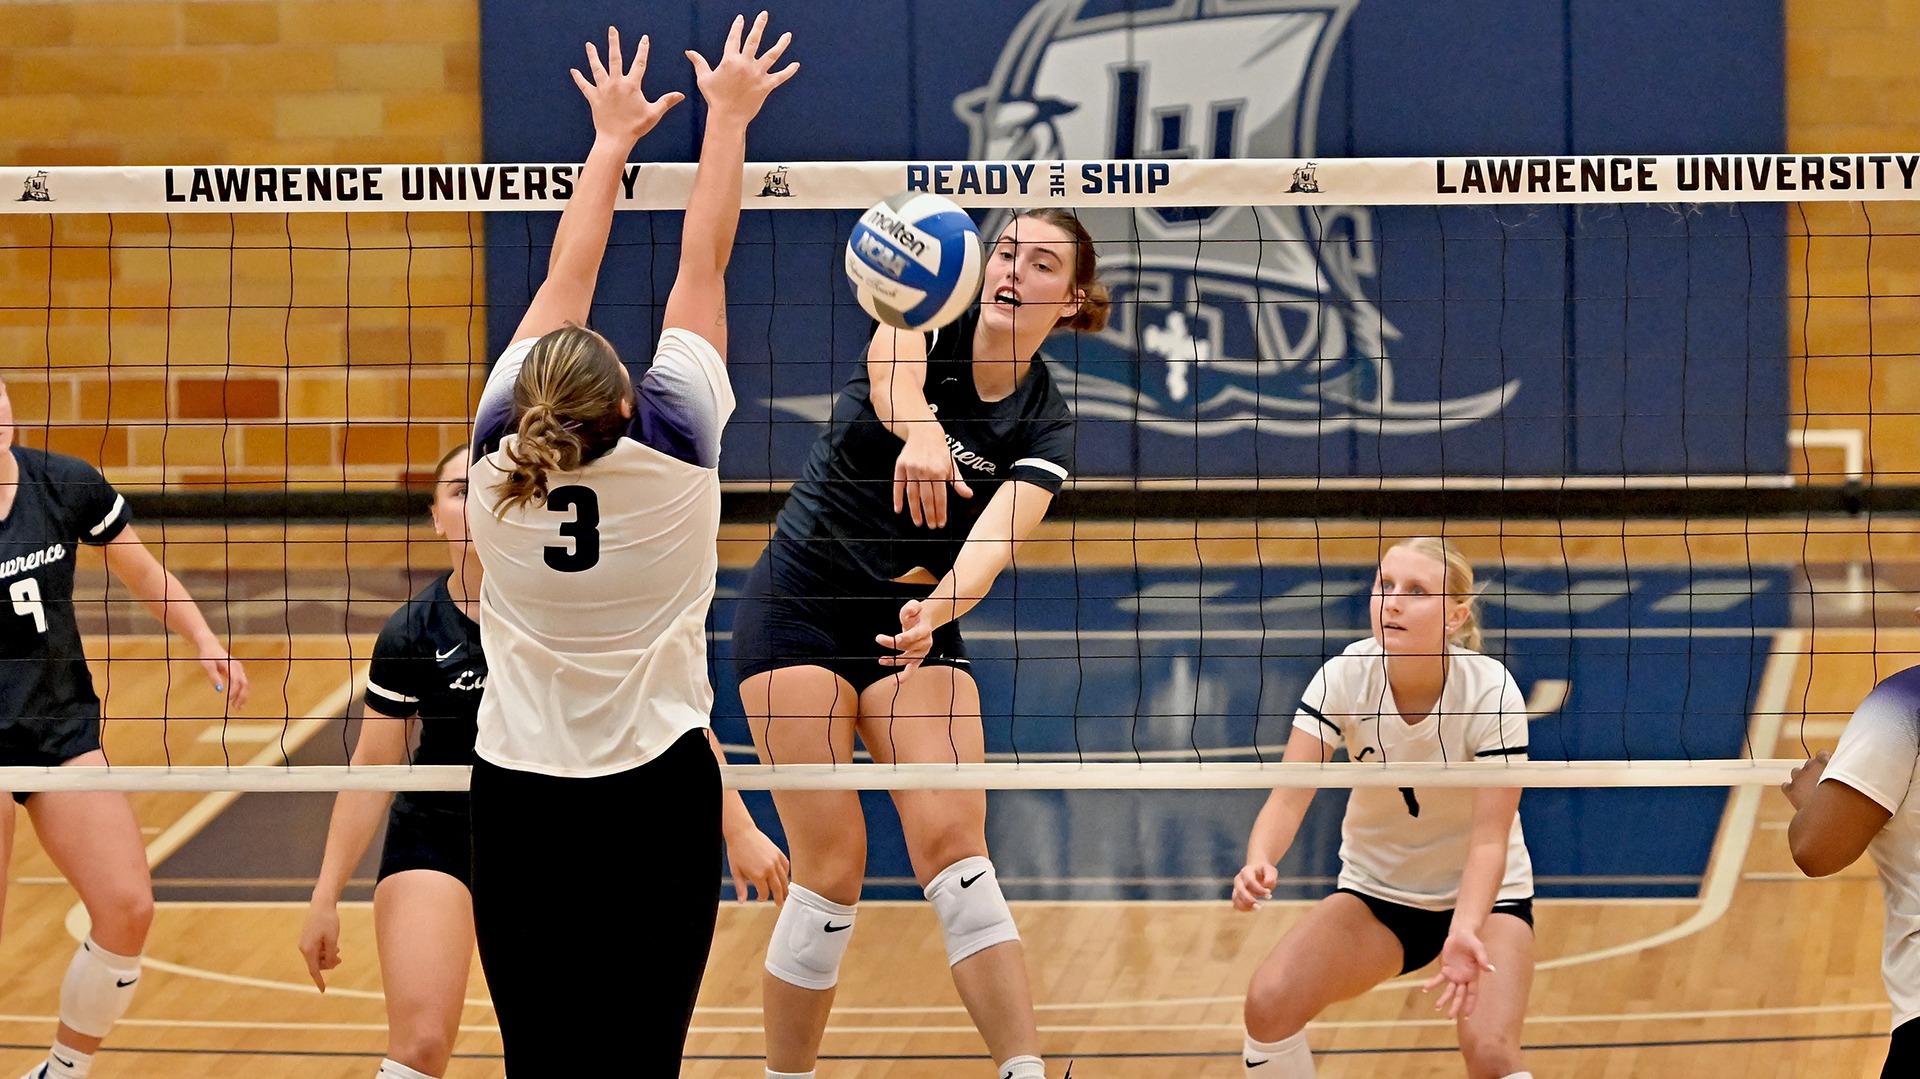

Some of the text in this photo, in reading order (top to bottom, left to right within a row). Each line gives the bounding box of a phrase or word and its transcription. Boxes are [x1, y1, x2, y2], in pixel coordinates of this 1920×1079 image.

[165, 165, 641, 202] LAWRENCE UNIVERSY
[907, 162, 1170, 197] READY THE SHIP
[1436, 155, 1920, 194] LAWRENCE UNIVERSITY
[867, 211, 927, 257] molten
[543, 484, 600, 573] 3
[9, 577, 47, 633] 9
